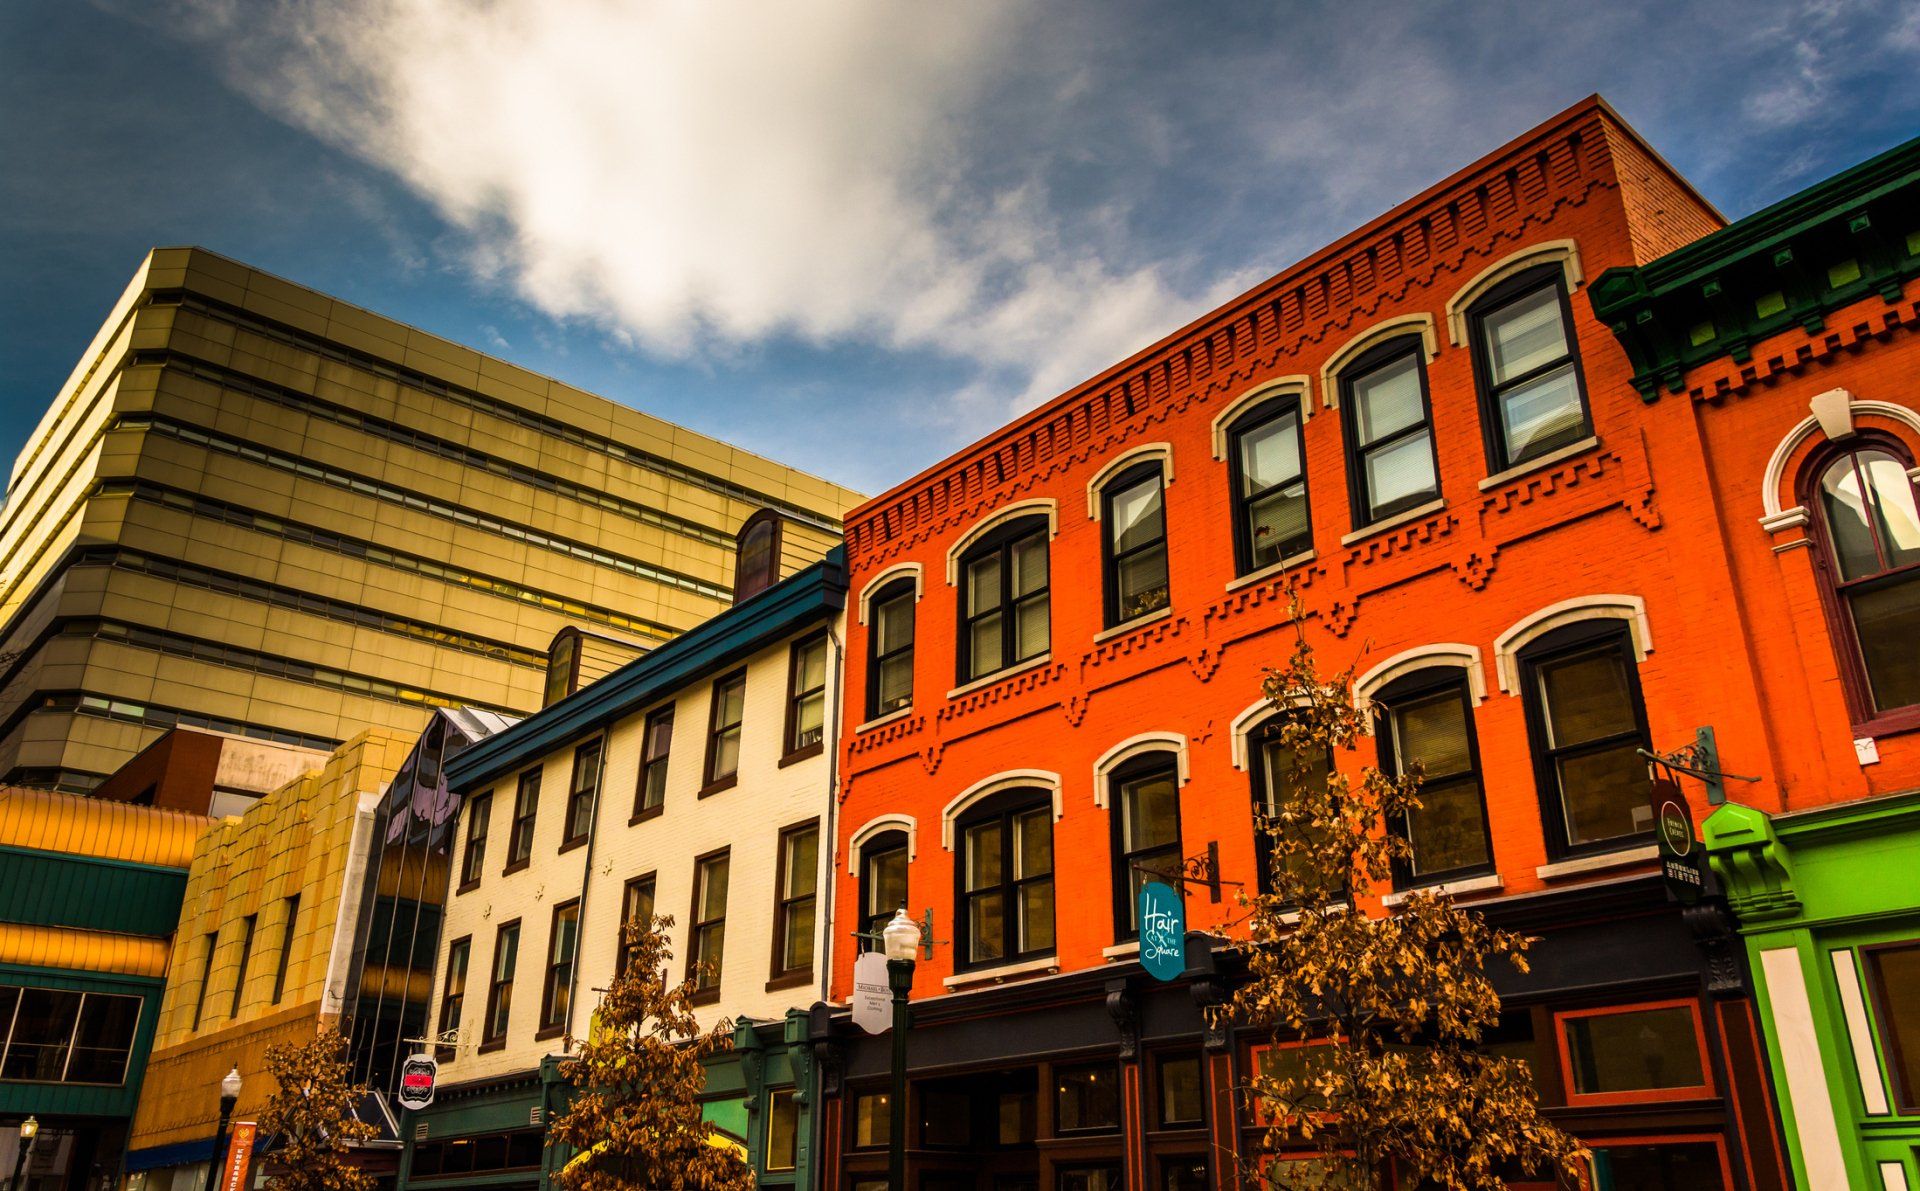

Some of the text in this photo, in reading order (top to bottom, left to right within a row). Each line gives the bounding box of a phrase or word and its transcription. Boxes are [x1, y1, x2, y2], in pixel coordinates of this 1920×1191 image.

[1667, 868, 1700, 885] BISTRO
[1144, 892, 1179, 935] Hair
[1145, 930, 1180, 966] Square
